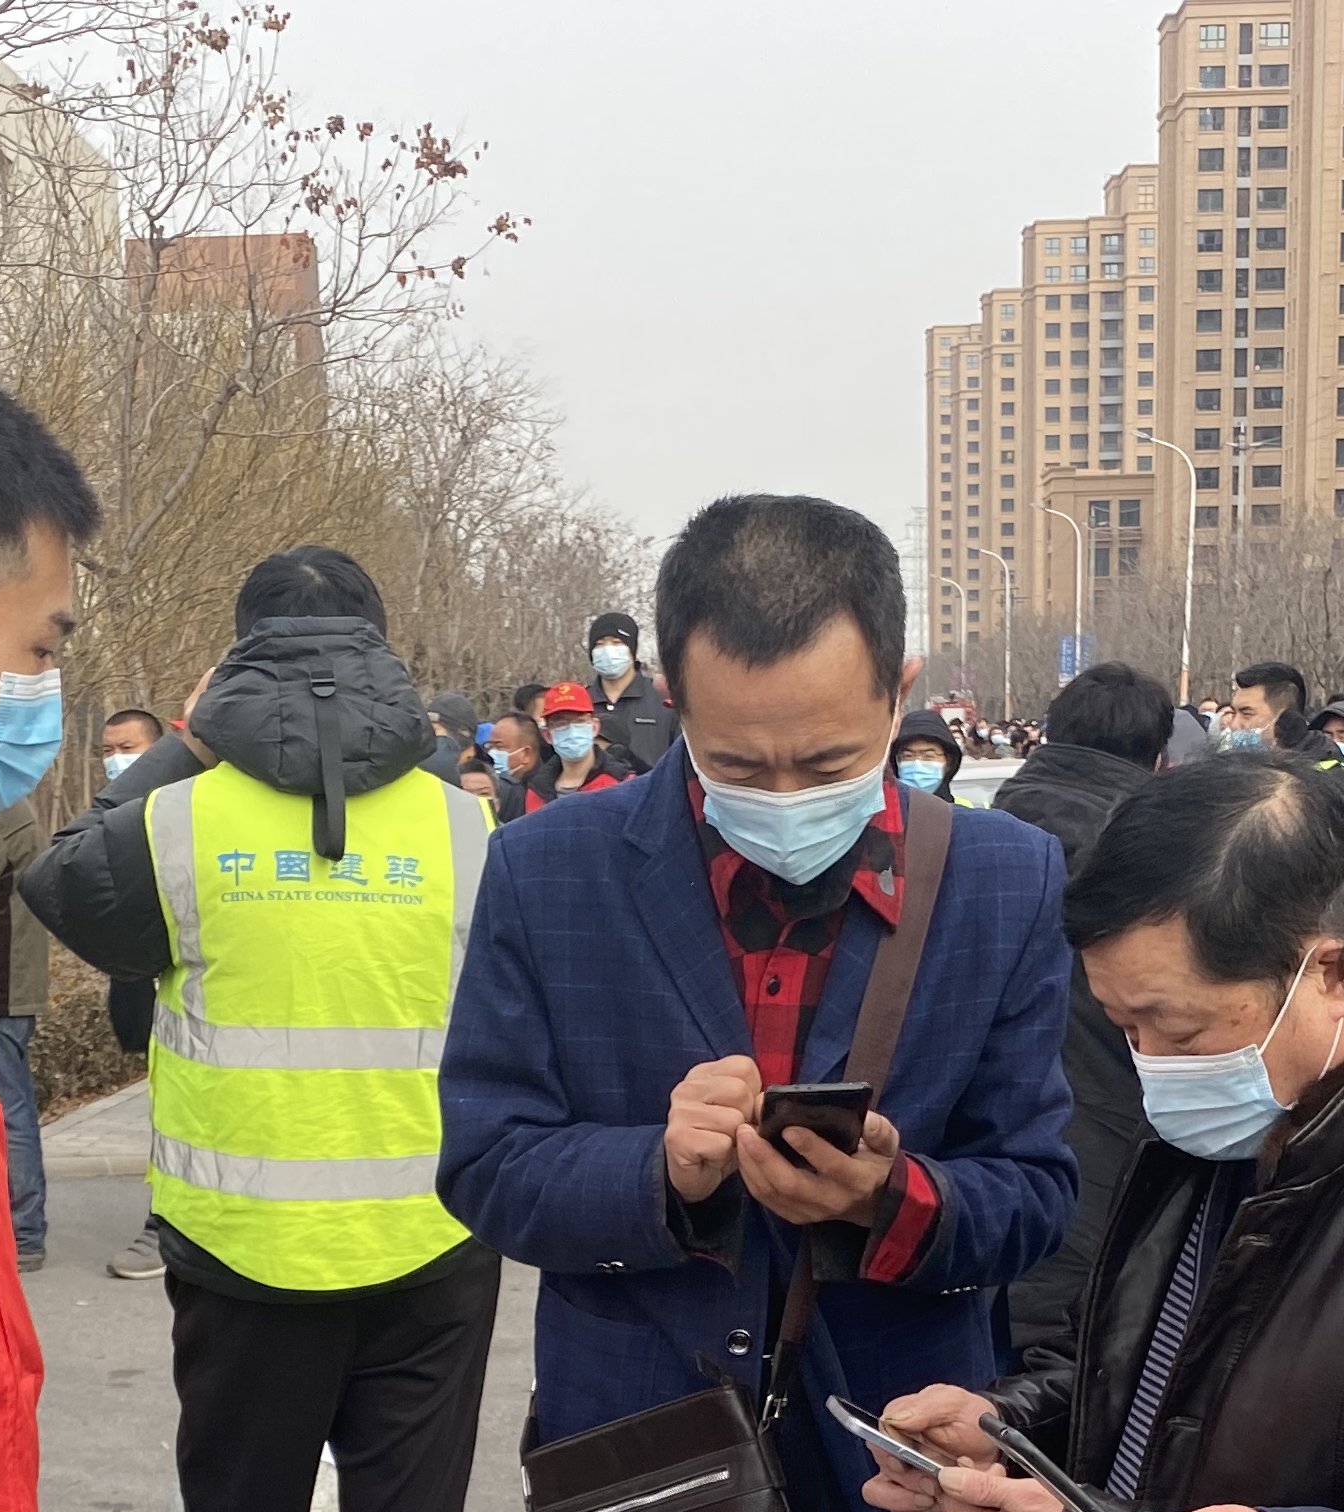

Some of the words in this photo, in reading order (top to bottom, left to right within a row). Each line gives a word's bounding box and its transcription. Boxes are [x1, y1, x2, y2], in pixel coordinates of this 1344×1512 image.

[221, 892, 264, 903] CHINA
[267, 890, 313, 902] STATE
[315, 890, 424, 906] CONSTRUCTION
